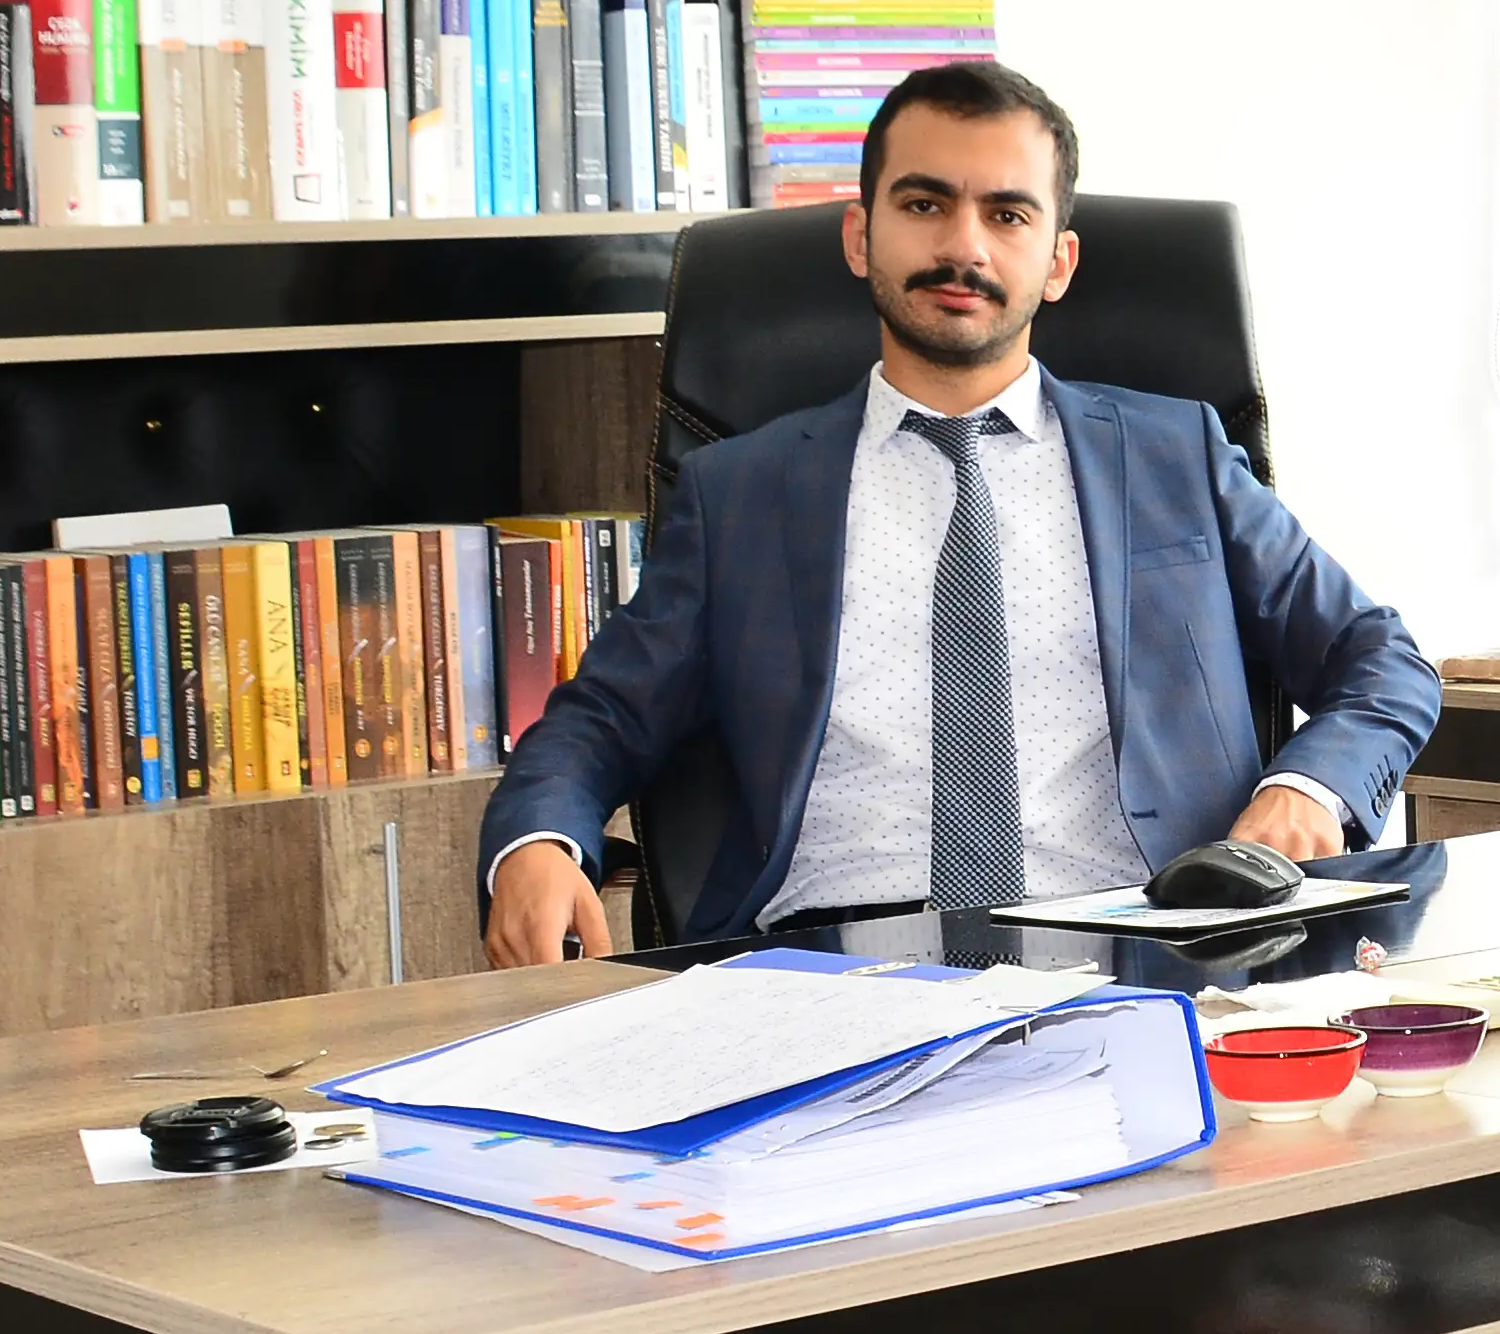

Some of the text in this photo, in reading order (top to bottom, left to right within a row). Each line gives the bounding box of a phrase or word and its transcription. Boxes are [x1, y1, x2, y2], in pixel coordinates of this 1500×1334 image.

[267, 601, 288, 653] ANA
[177, 603, 194, 670] SEFİLLER
[186, 727, 199, 760] HUGO
[204, 595, 226, 748] ÖLÜ CANLAR GOGOL
[236, 639, 250, 675] NANA
[242, 726, 253, 751] ZOLA
